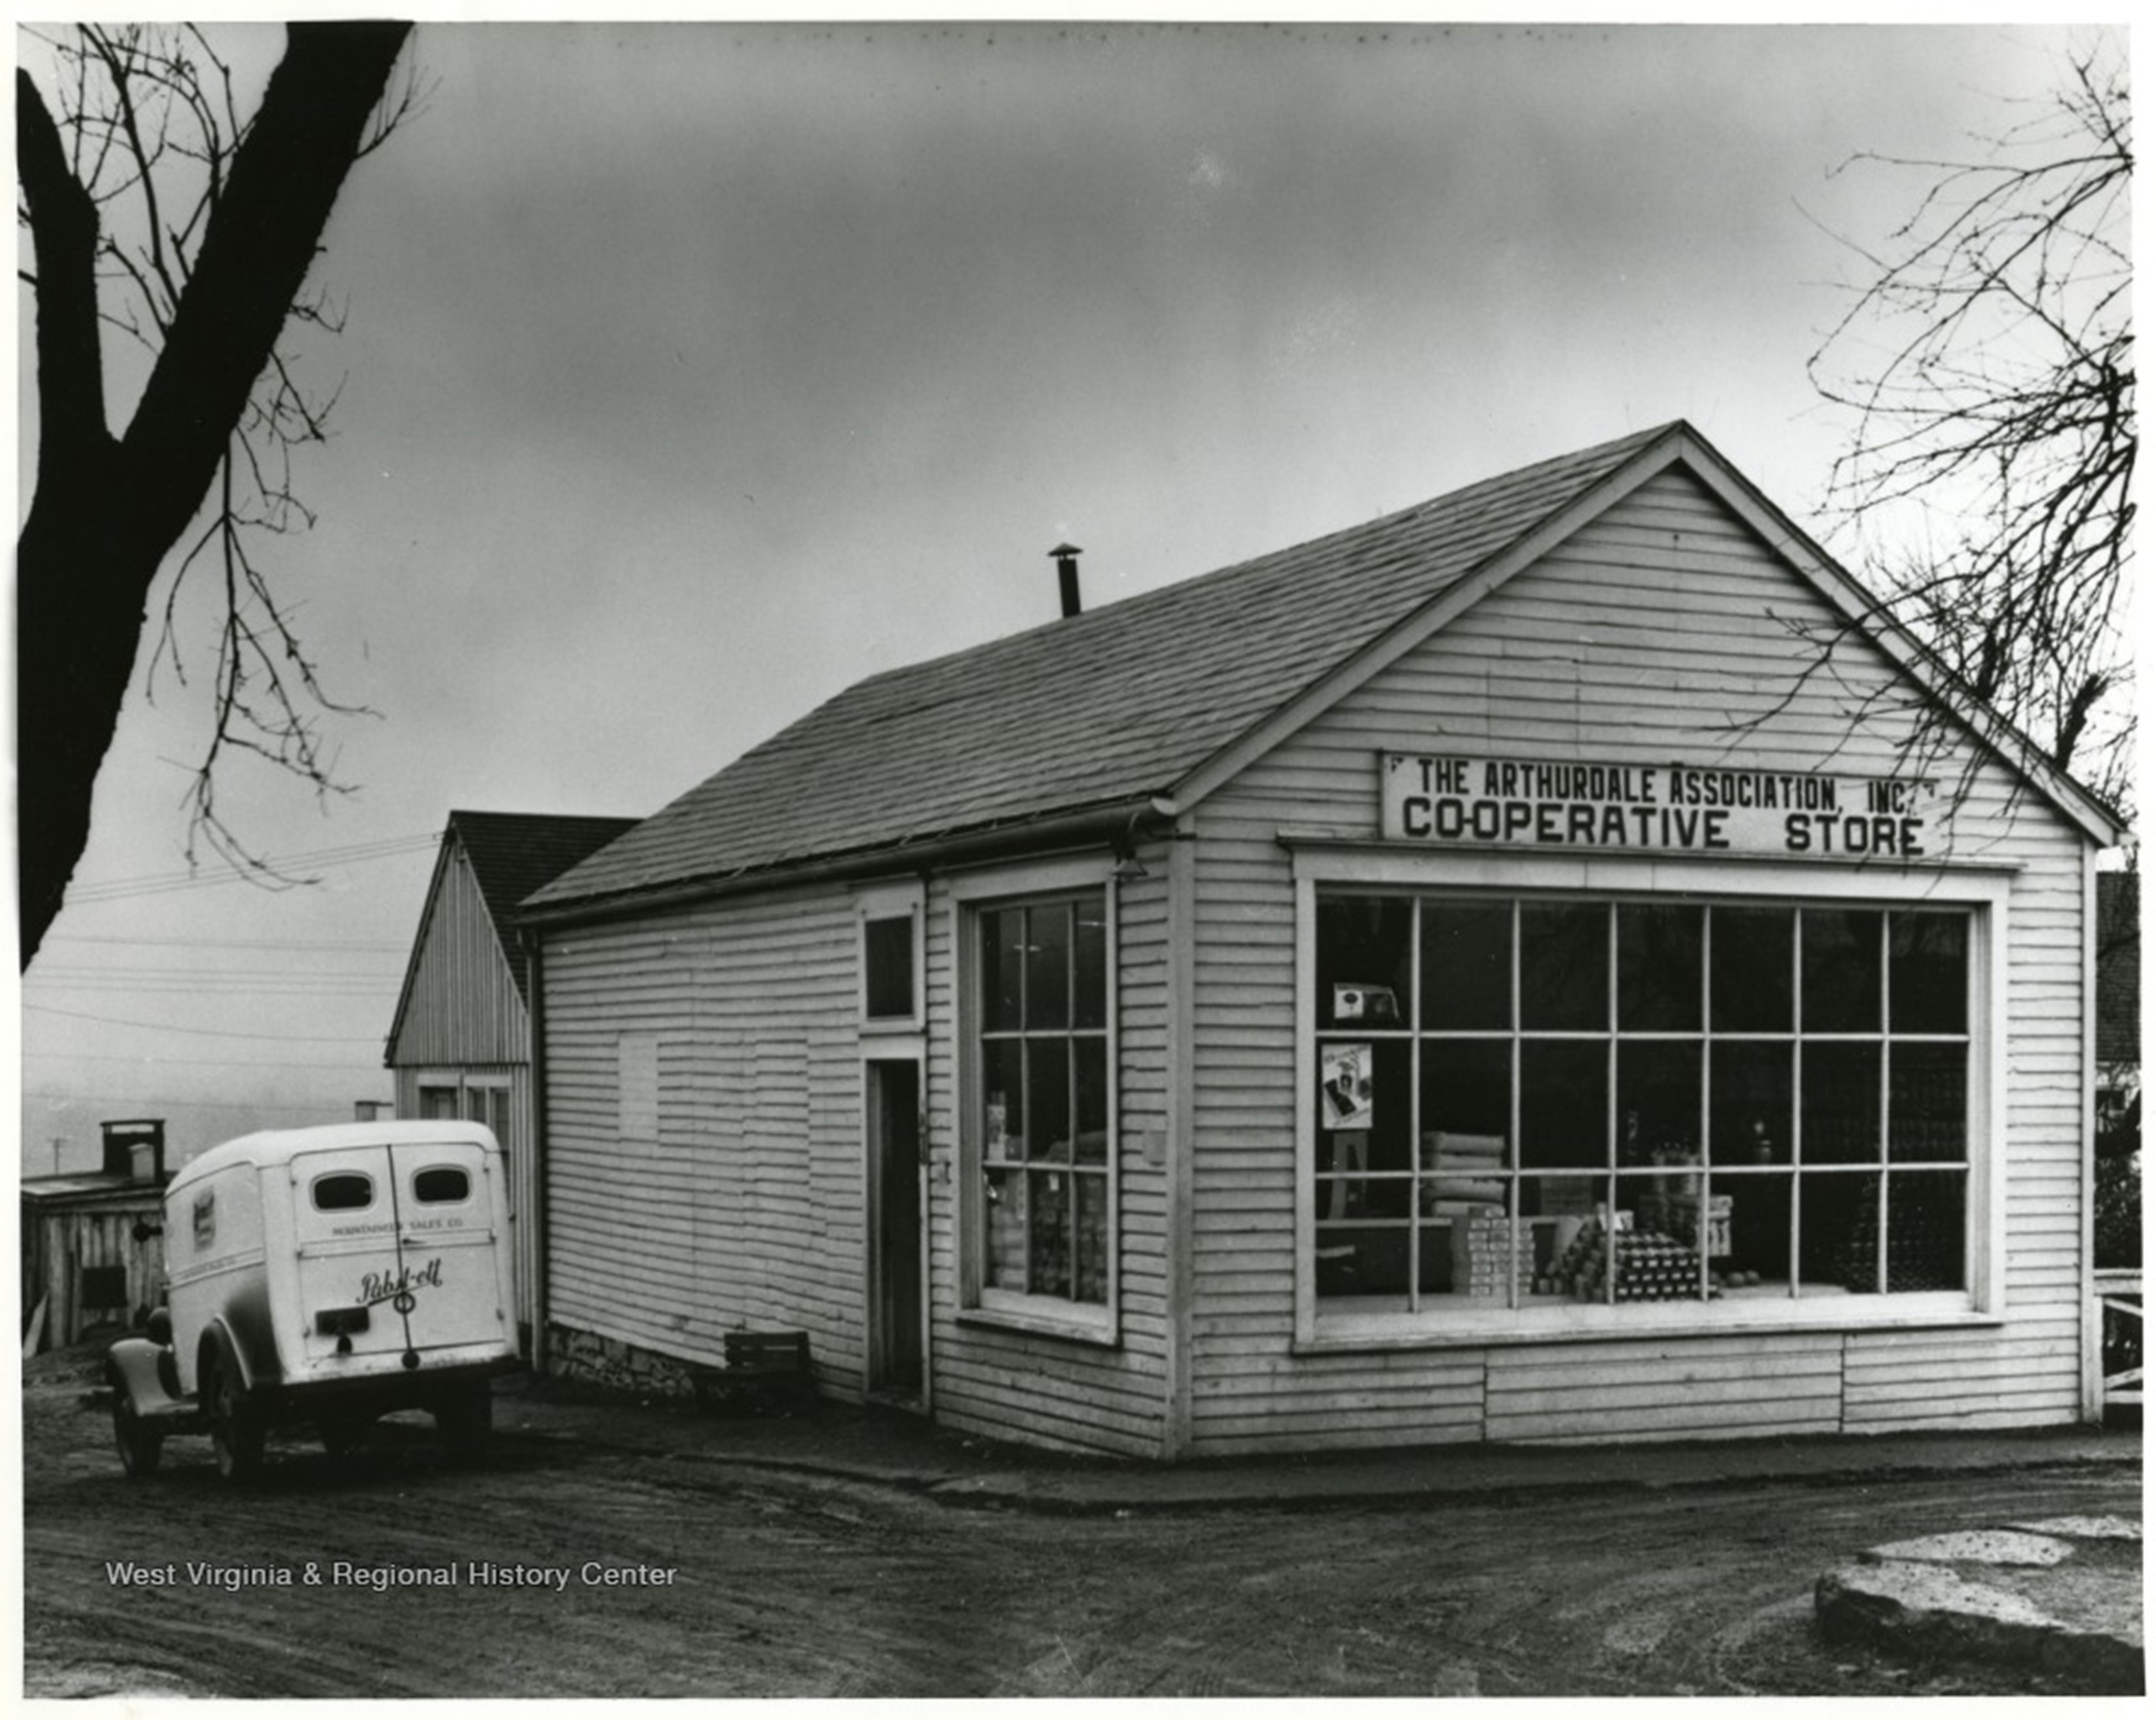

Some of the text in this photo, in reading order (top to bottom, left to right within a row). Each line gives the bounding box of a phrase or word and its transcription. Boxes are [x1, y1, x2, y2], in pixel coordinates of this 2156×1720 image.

[1418, 758, 1469, 795] THE
[1484, 762, 1657, 803] ARTHURDALE
[1403, 796, 1924, 856] CO-OPERATIVE STORE
